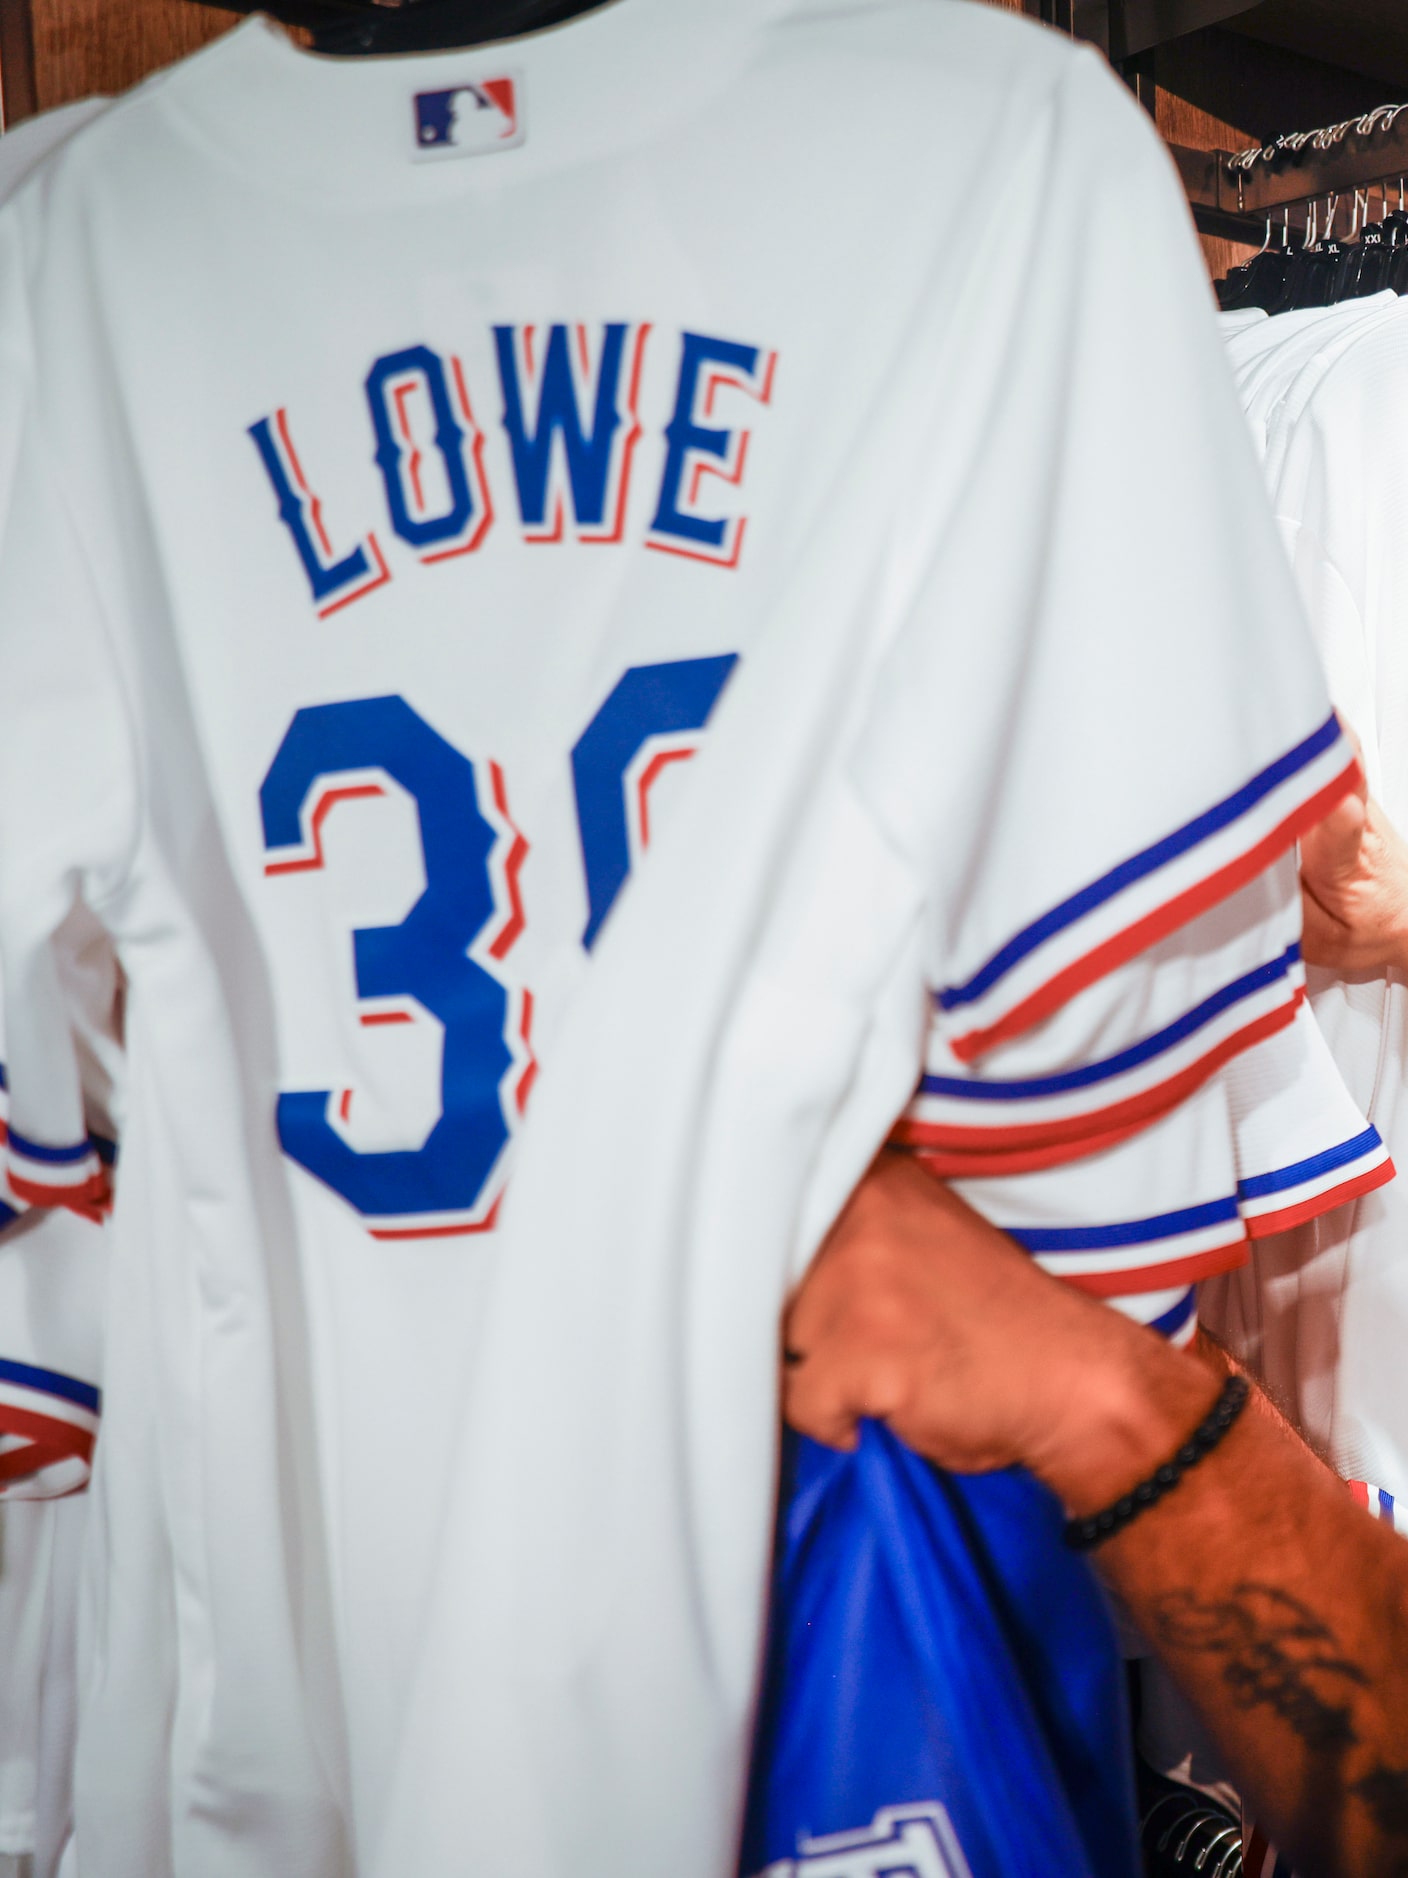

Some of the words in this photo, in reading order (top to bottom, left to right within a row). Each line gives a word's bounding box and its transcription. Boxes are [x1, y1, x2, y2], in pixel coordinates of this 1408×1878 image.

[1286, 246, 1294, 256] L
[1328, 243, 1340, 255] XL
[246, 323, 778, 619] LOWE
